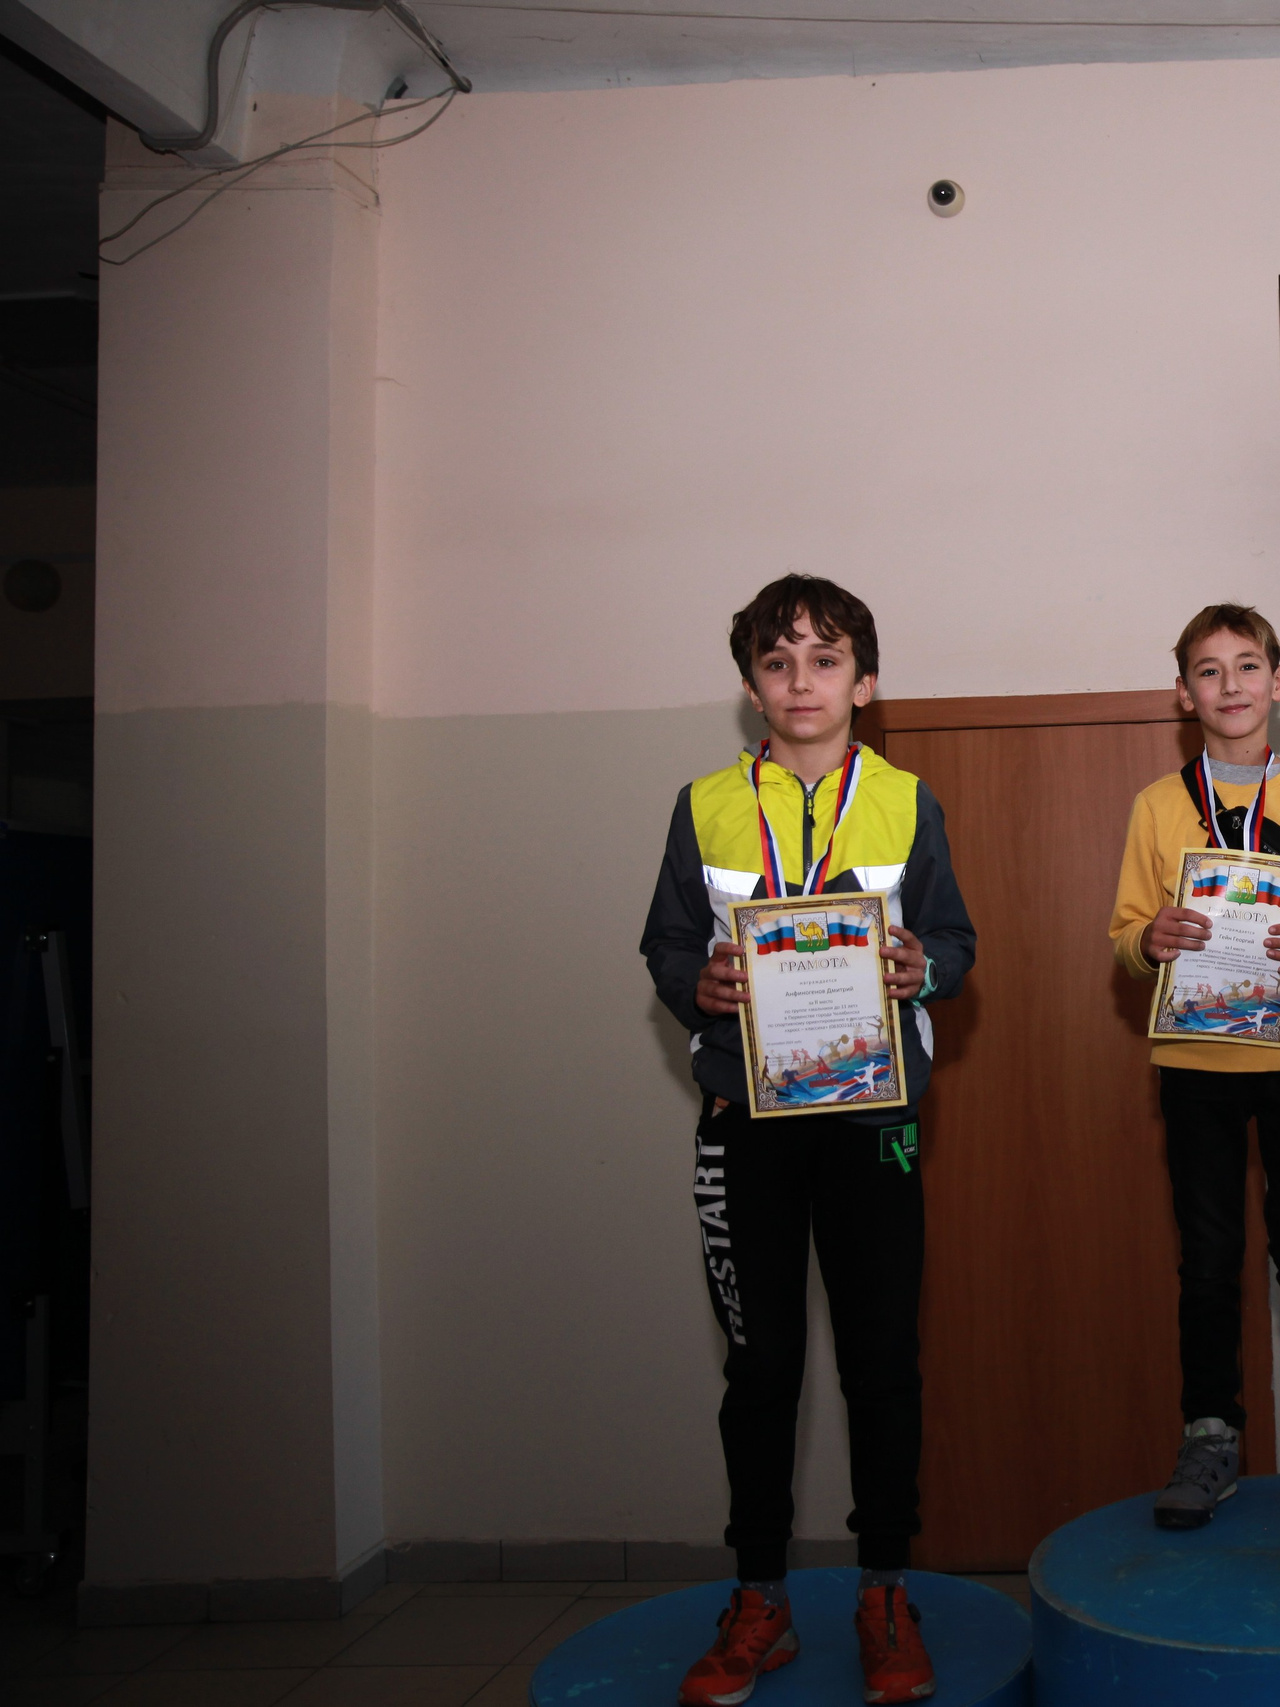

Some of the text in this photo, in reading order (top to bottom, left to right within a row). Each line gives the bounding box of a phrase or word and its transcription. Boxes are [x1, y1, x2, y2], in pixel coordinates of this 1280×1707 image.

[779, 957, 848, 972] ГРАМОТА
[827, 986, 854, 995] Дмитрий
[693, 1135, 748, 1346] RESTART
